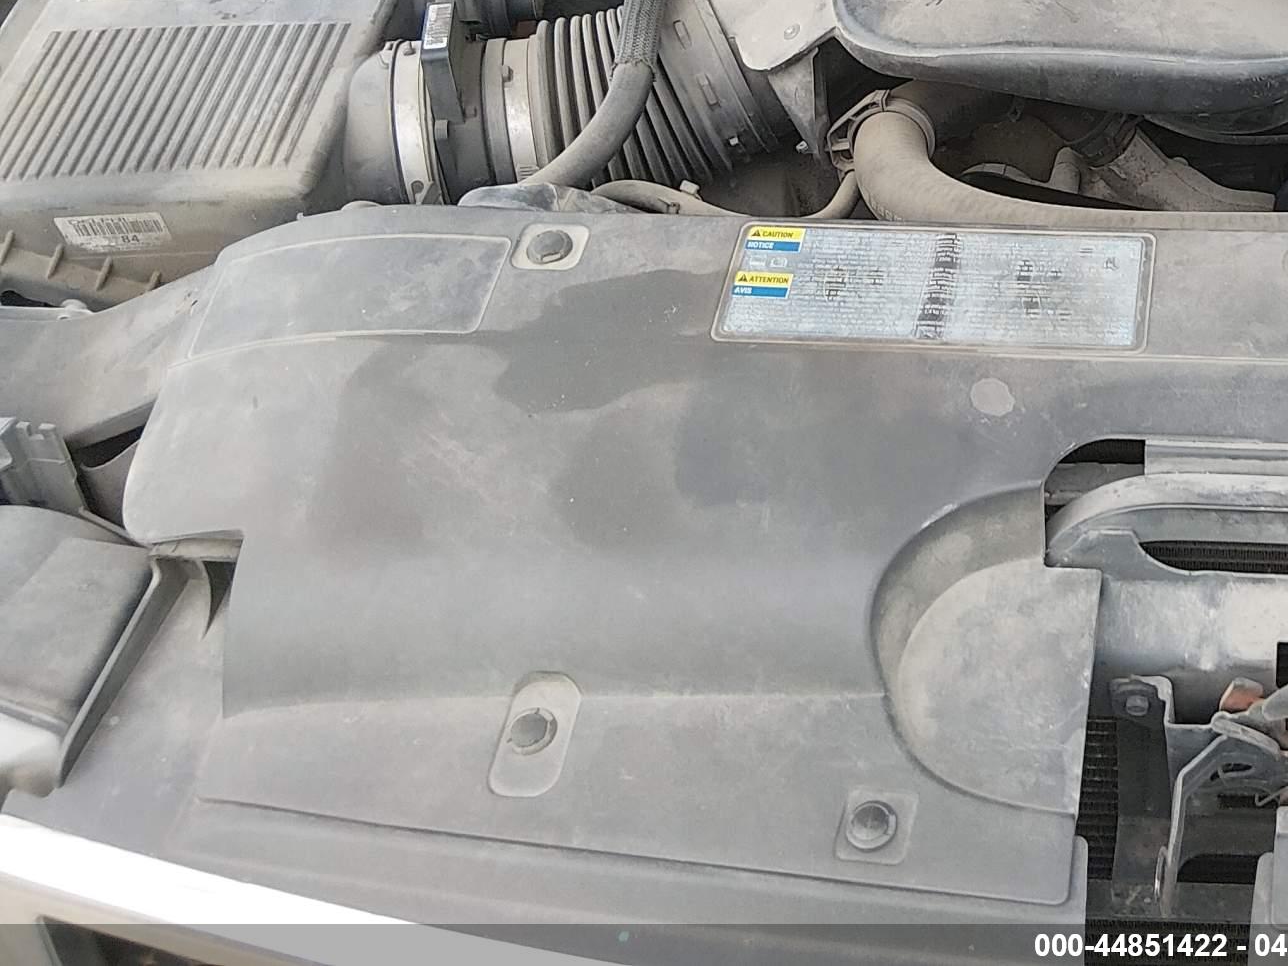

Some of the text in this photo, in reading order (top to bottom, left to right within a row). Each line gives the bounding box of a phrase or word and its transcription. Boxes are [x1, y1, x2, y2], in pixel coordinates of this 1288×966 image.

[747, 241, 775, 249] NOTICE
[748, 276, 789, 284] ATTENTION
[733, 286, 753, 294] AVIS
